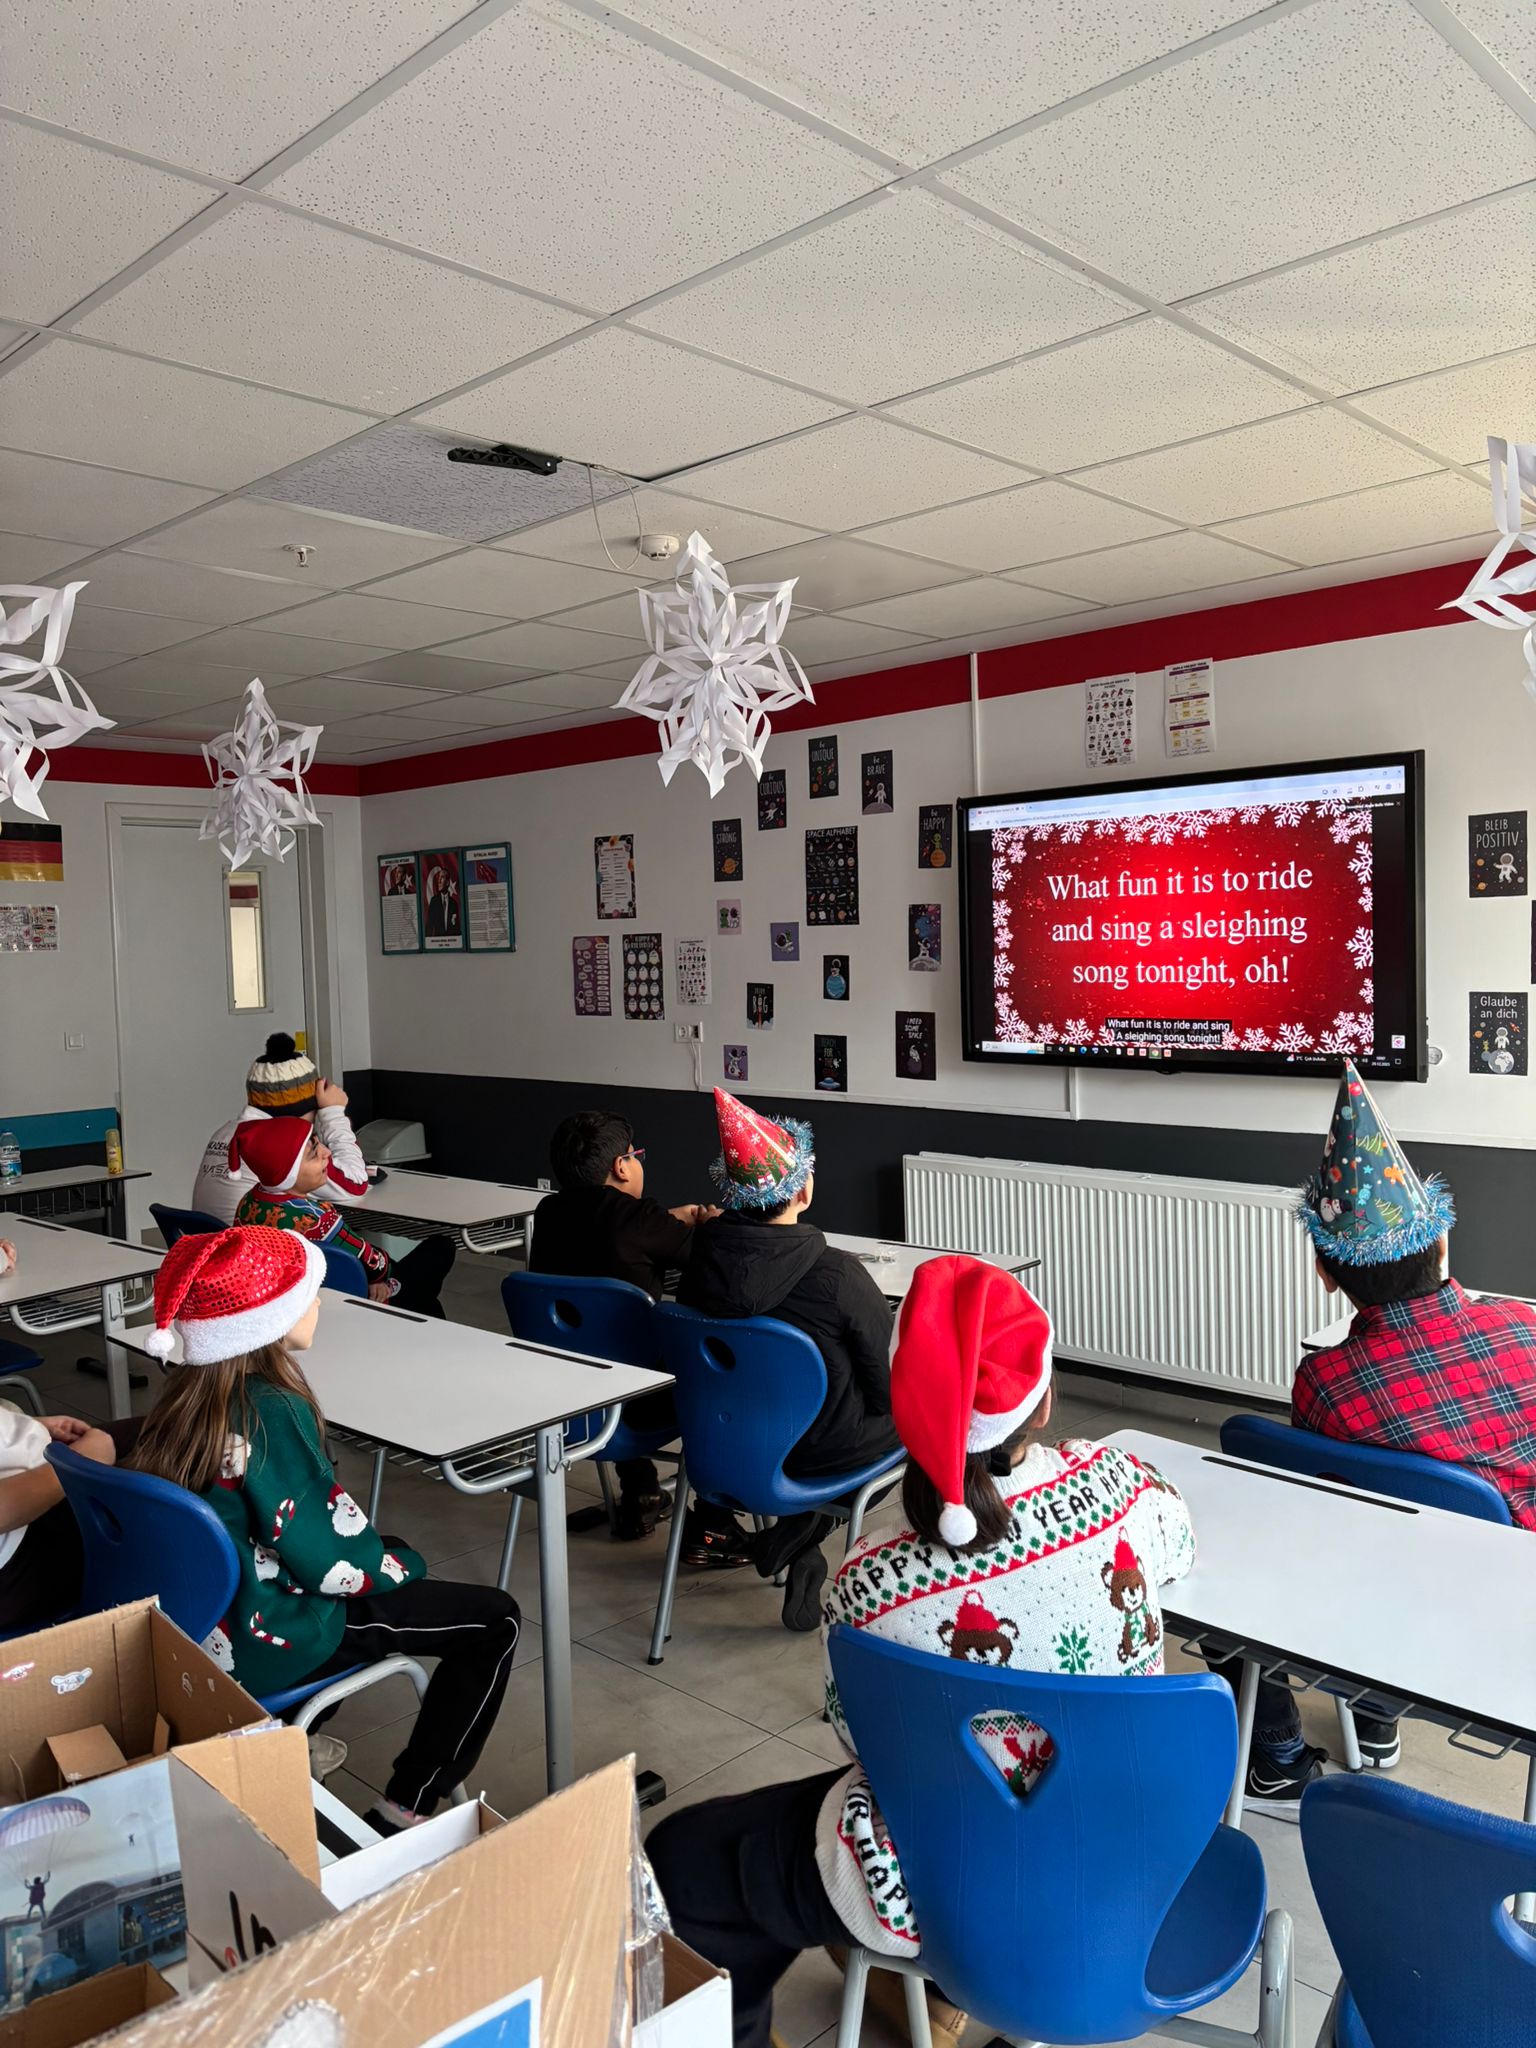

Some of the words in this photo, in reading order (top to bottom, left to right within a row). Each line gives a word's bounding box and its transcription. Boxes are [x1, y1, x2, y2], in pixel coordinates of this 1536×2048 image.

[867, 764, 886, 776] BRAVE
[923, 817, 946, 831] HAPPY
[1485, 818, 1509, 832] BLEIB
[716, 832, 737, 844] STRONG
[806, 830, 825, 838] SPACE
[826, 826, 856, 836] ALPHABET
[1476, 831, 1519, 848] POSITIV
[1047, 874, 1109, 900] What
[1117, 871, 1158, 897] fun
[1167, 868, 1184, 894] it
[1193, 866, 1214, 893] is
[1222, 868, 1249, 891] to
[1257, 861, 1313, 890] ride
[1052, 916, 1093, 941] and
[1101, 914, 1152, 946] sing
[1160, 920, 1174, 939] a
[1182, 909, 1308, 944] sleighing
[1073, 964, 1128, 990] song
[1135, 956, 1236, 990] tonight,
[1244, 955, 1289, 984] oh!
[1480, 995, 1518, 1007] Glaube
[1480, 1010, 1493, 1018] an
[1496, 1008, 1518, 1019] dich
[904, 1024, 920, 1032] SOME
[1108, 1019, 1129, 1028] What
[1130, 1020, 1144, 1029] fun
[1146, 1020, 1152, 1029] it
[1154, 1020, 1161, 1029] is
[1163, 1021, 1172, 1029] to
[1174, 1020, 1190, 1029] ride
[1192, 1021, 1209, 1030] and
[1211, 1022, 1230, 1032] sing
[908, 1031, 923, 1039] SPACE
[1116, 1032, 1123, 1040] A
[1124, 1031, 1161, 1043] sleighing
[1163, 1035, 1185, 1044] song
[1187, 1034, 1221, 1044] tonight!
[1033, 1486, 1100, 1528] YEAR
[839, 1547, 932, 1610] HAPPY
